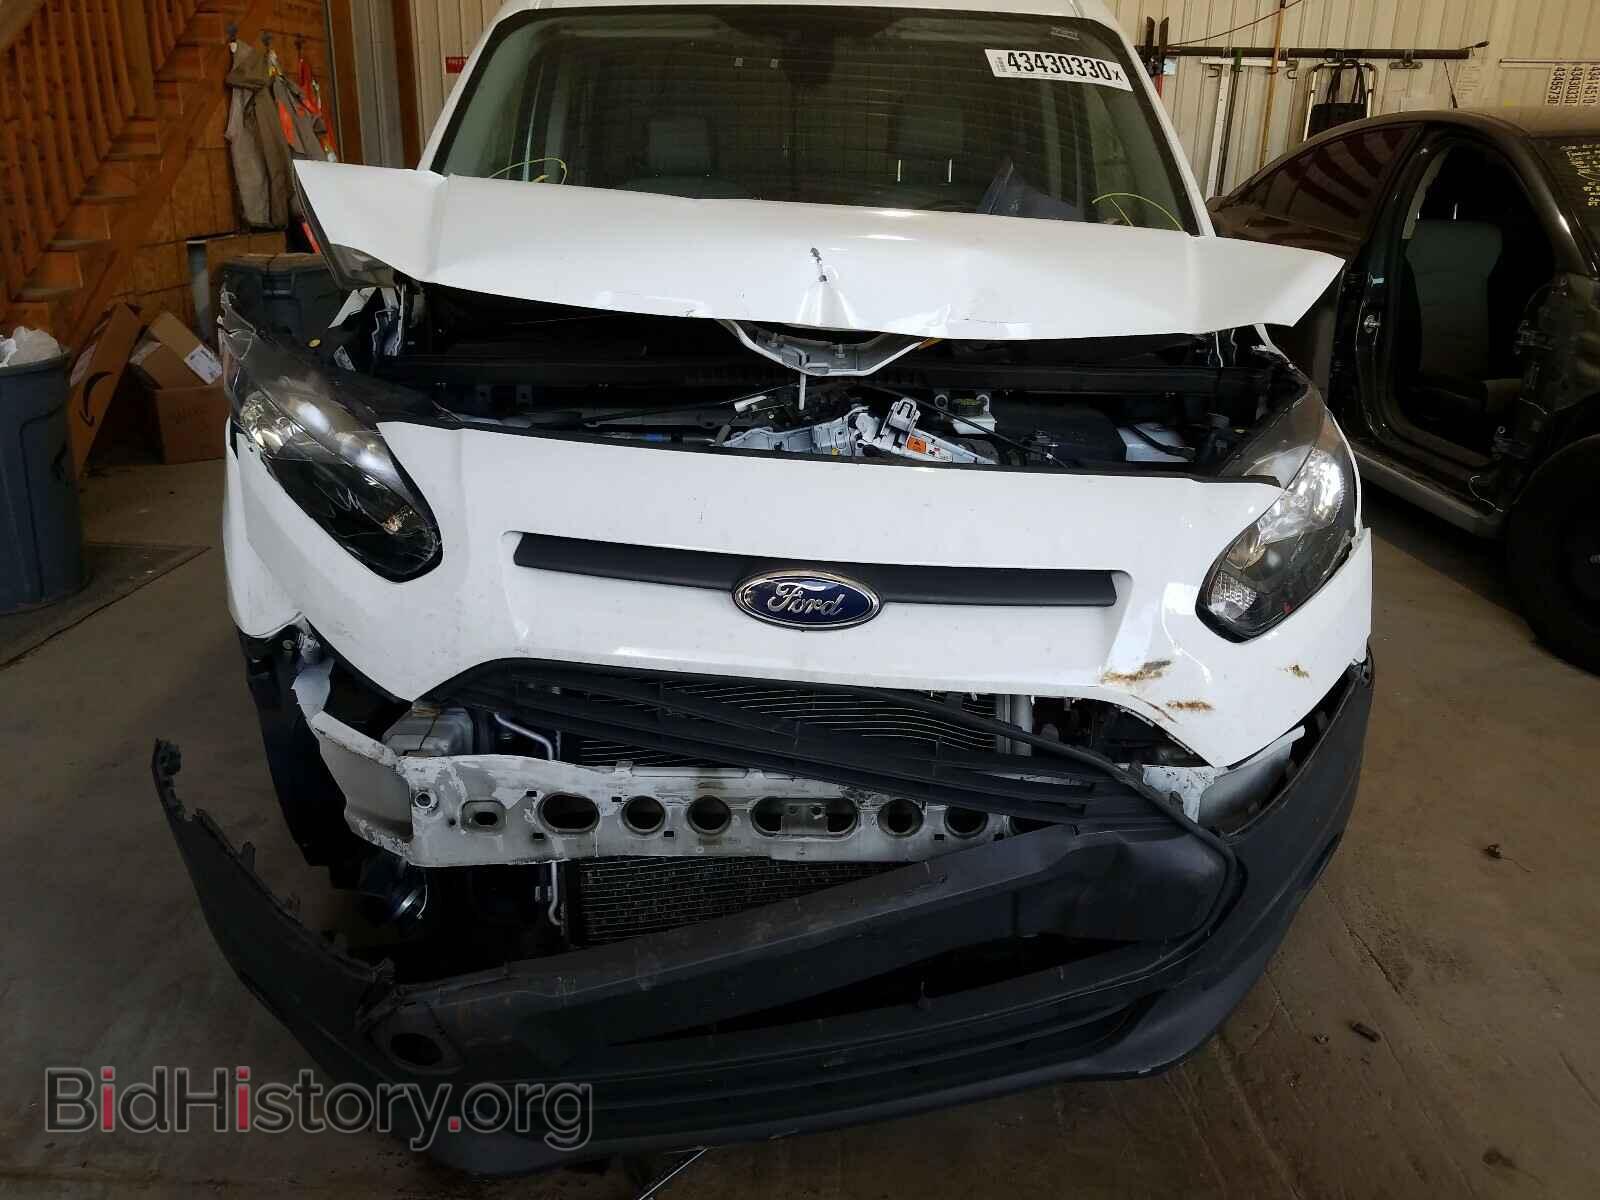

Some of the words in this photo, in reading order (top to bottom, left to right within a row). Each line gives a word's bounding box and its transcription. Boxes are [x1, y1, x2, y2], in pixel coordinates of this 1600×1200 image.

[1007, 51, 1112, 81] 43430330
[1547, 66, 1566, 104] 43455730
[1564, 66, 1584, 104] 43430330
[767, 582, 845, 616] Ford
